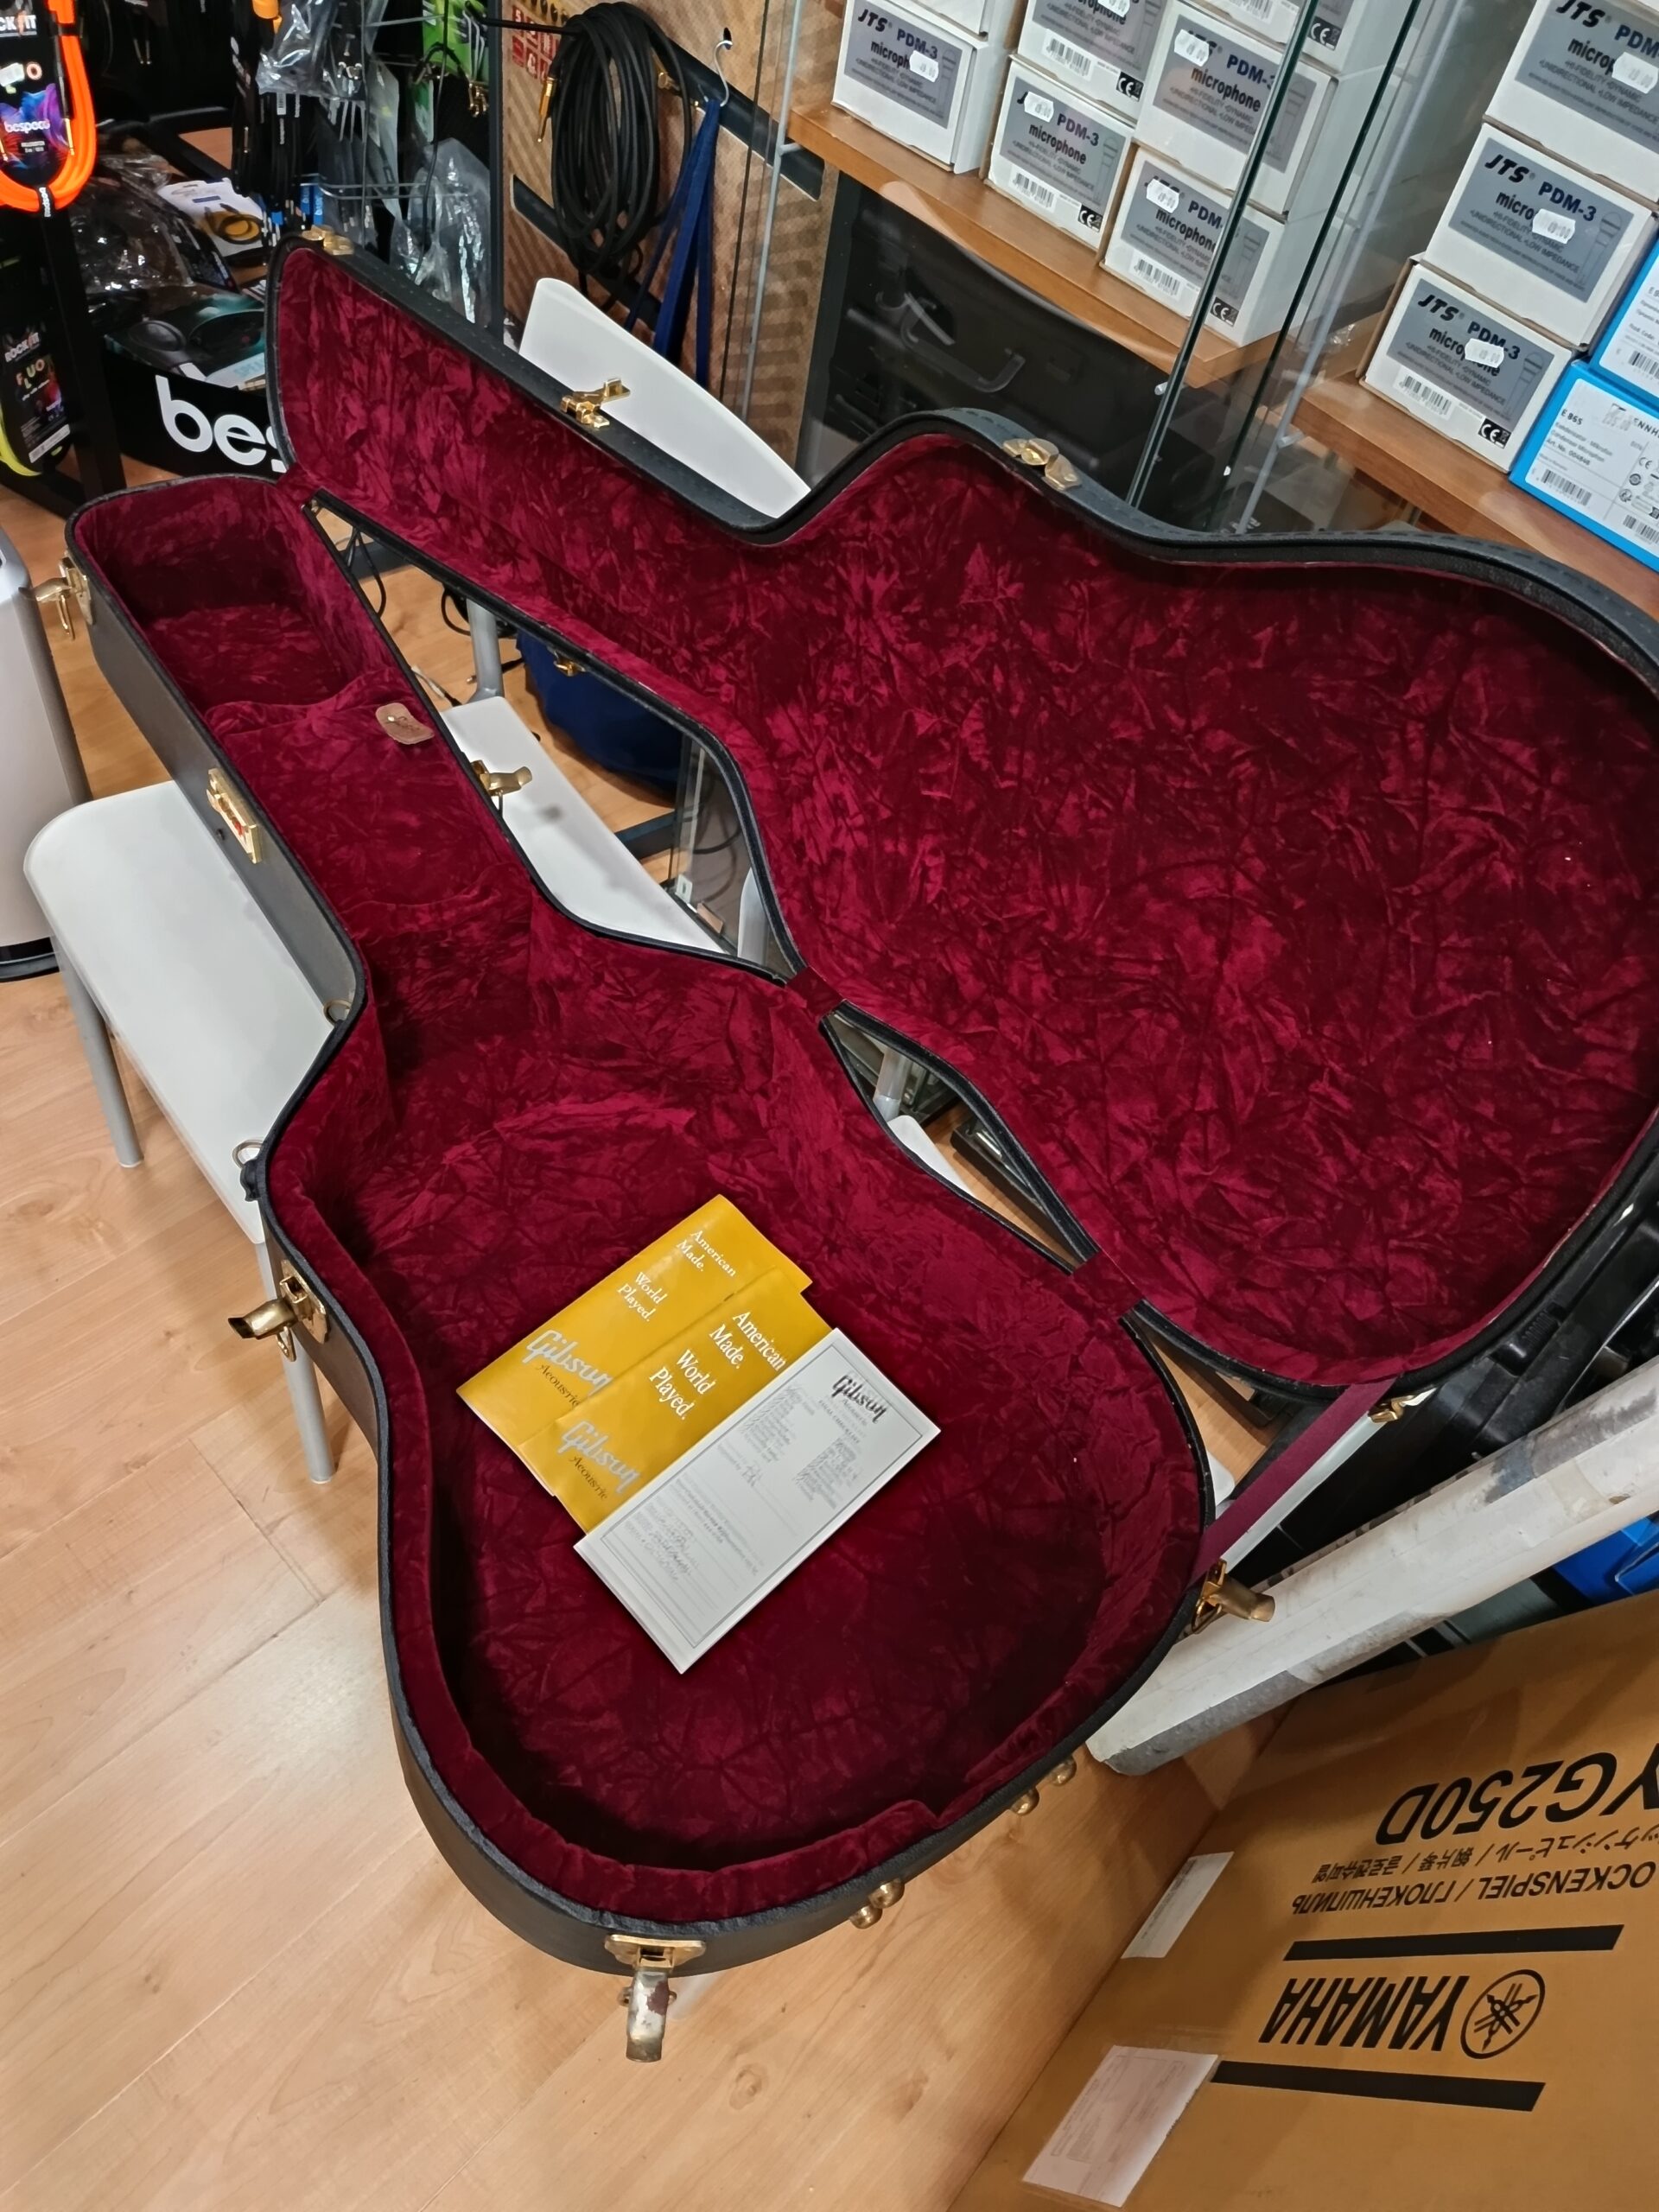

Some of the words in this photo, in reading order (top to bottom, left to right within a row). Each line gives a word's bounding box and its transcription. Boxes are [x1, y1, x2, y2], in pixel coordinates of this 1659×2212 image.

[858, 9, 888, 32] JTS
[896, 28, 938, 60] PDM-3
[1556, 0, 1605, 28] JTS
[870, 41, 911, 68] microph
[1567, 38, 1616, 75] microp
[1191, 67, 1262, 112] microphone
[1028, 124, 1087, 164] microphone
[1056, 112, 1100, 147] PDM-3
[1484, 154, 1529, 183] JTS
[1538, 181, 1597, 221] PDM-3
[1496, 192, 1535, 222] micro
[1417, 294, 1459, 321] JTS
[1467, 321, 1521, 360] PDM-3
[677, 1239, 705, 1272] Made.
[690, 1230, 737, 1277] American
[618, 1283, 657, 1322] Played.
[635, 1271, 668, 1305] World
[522, 1329, 613, 1397] Gibson
[709, 1324, 745, 1370] Made.
[732, 1311, 786, 1372] American
[649, 1365, 695, 1421] Played.
[676, 1349, 716, 1395] World
[831, 1375, 887, 1425] Gibson
[557, 1421, 640, 1494] Gibson
[569, 1455, 607, 1500] Acoustic
[1376, 1743, 1659, 1845] YG250D
[1496, 1823, 1659, 1863] ッケンシュピール
[1293, 1880, 1457, 1915] ГЛОКЕНШПИЛЬ
[1478, 1861, 1656, 1900] OCKENSPIEL
[1258, 1975, 1471, 2051] YAMAHA
